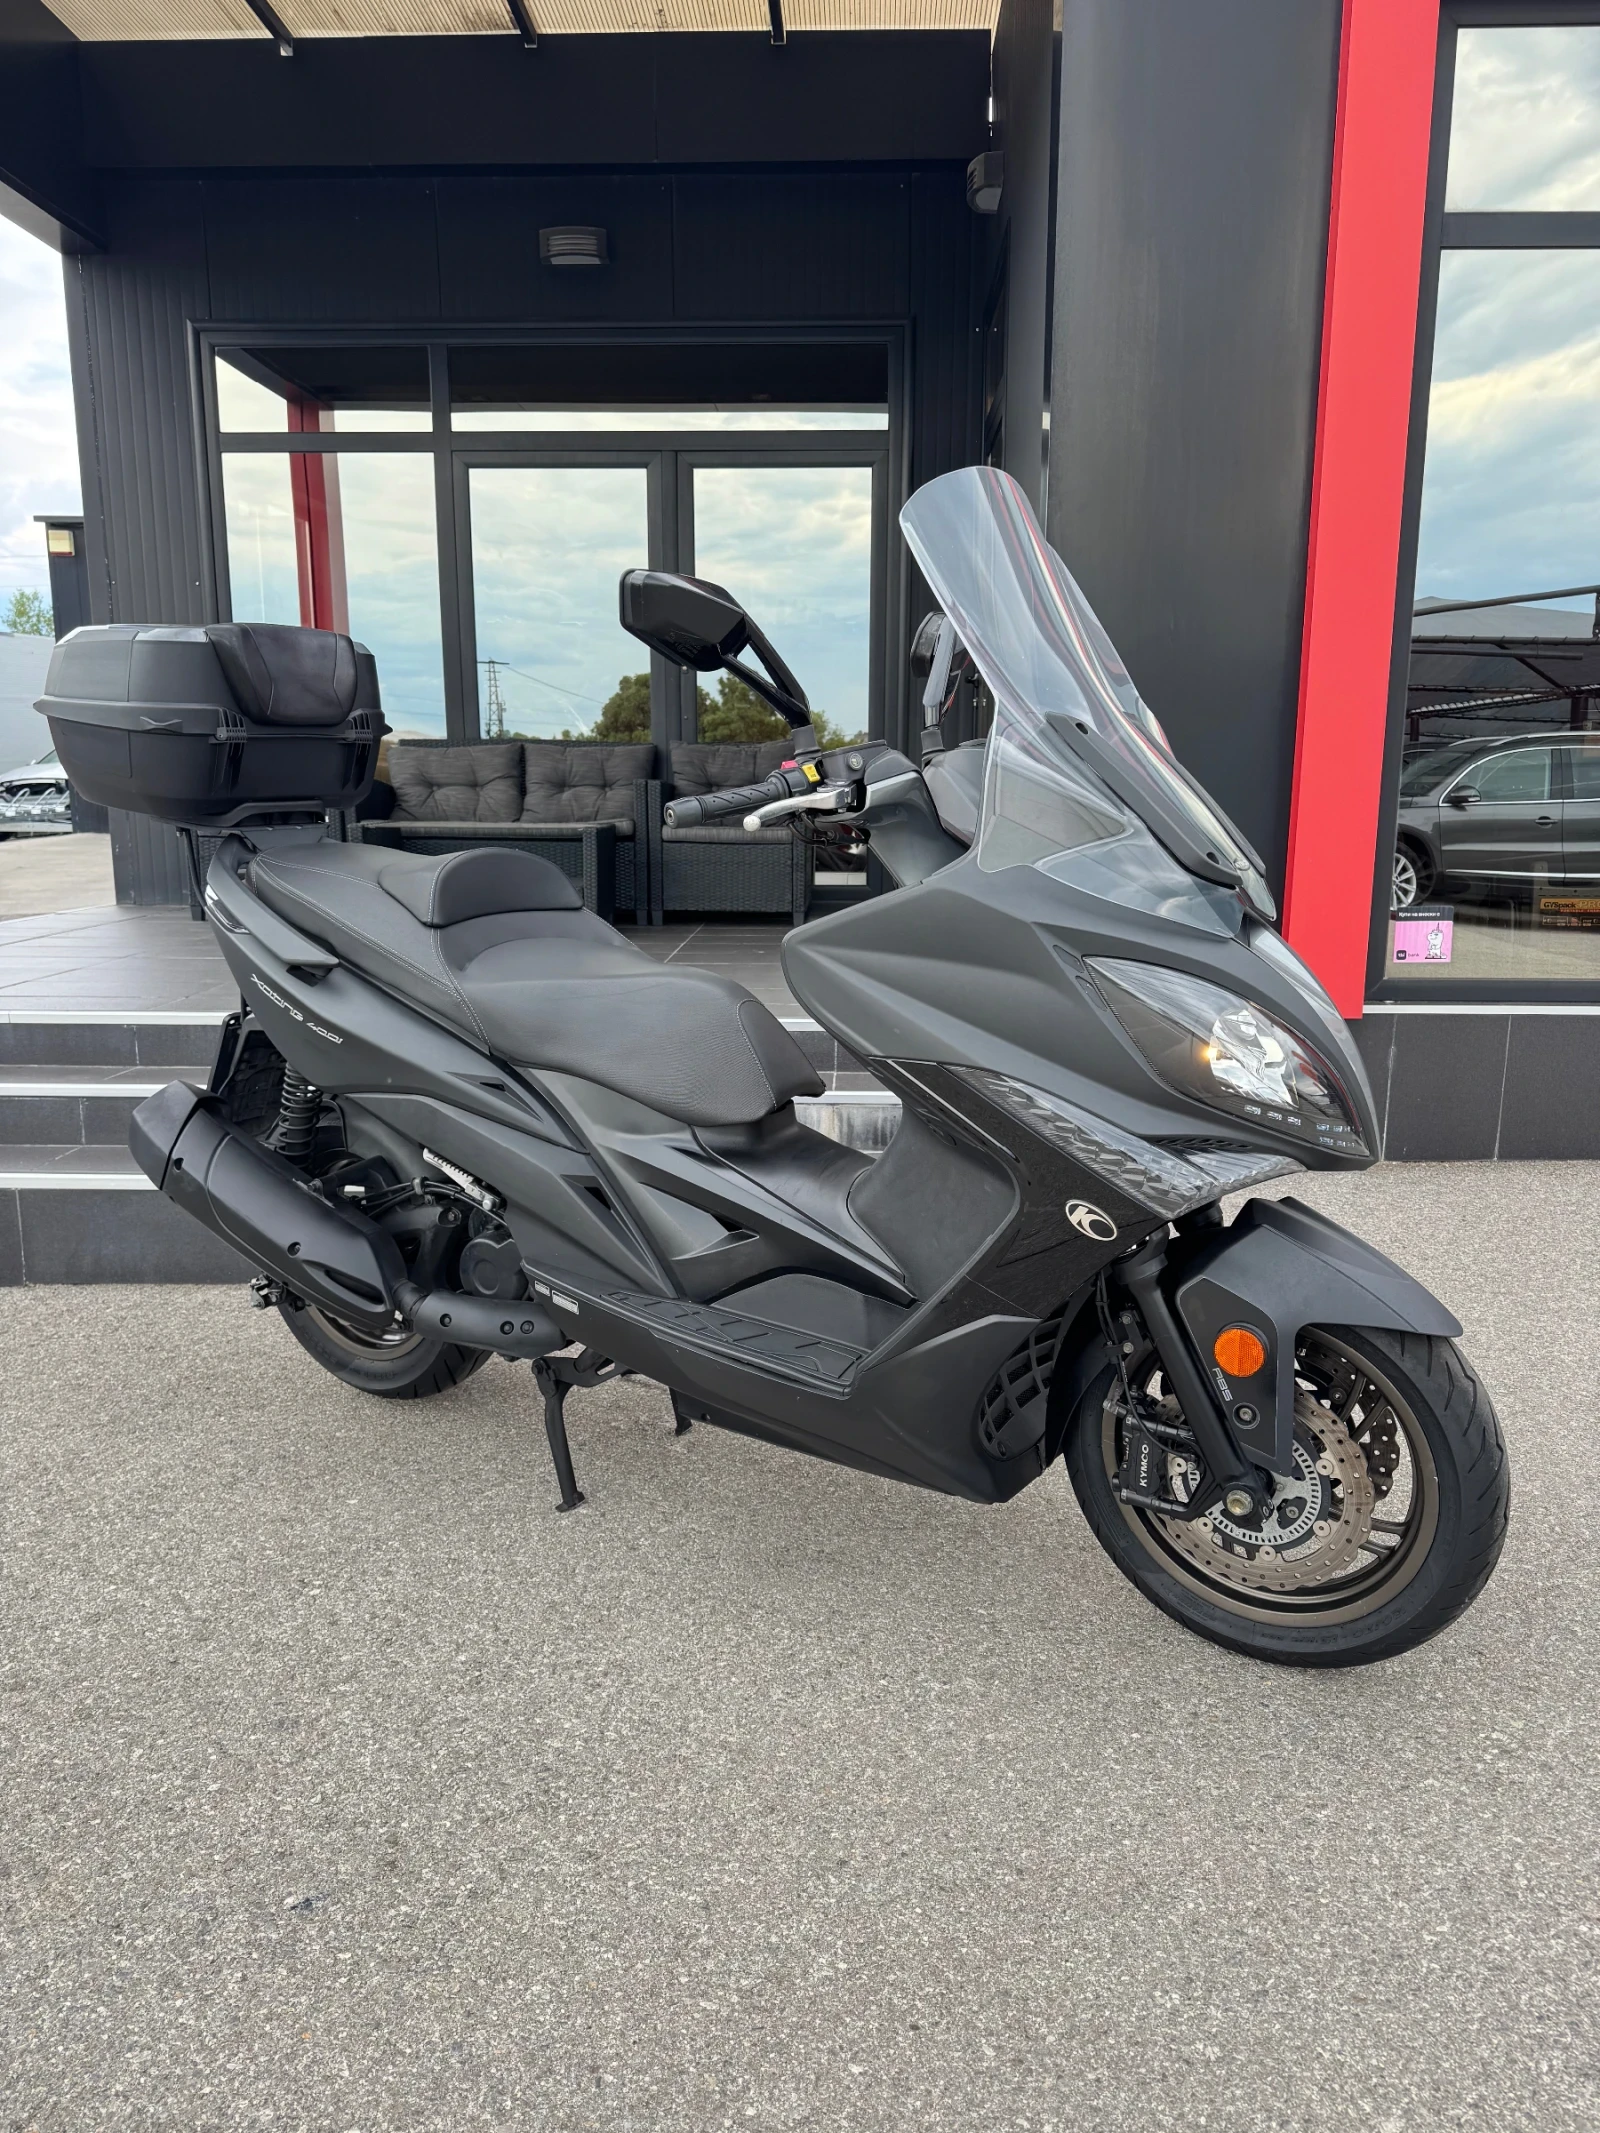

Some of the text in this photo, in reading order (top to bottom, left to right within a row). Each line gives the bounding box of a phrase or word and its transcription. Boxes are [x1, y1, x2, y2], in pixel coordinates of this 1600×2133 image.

[306, 1022, 343, 1044] 400i
[1212, 1367, 1233, 1402] ABS
[1139, 1444, 1149, 1488] KYMCO
